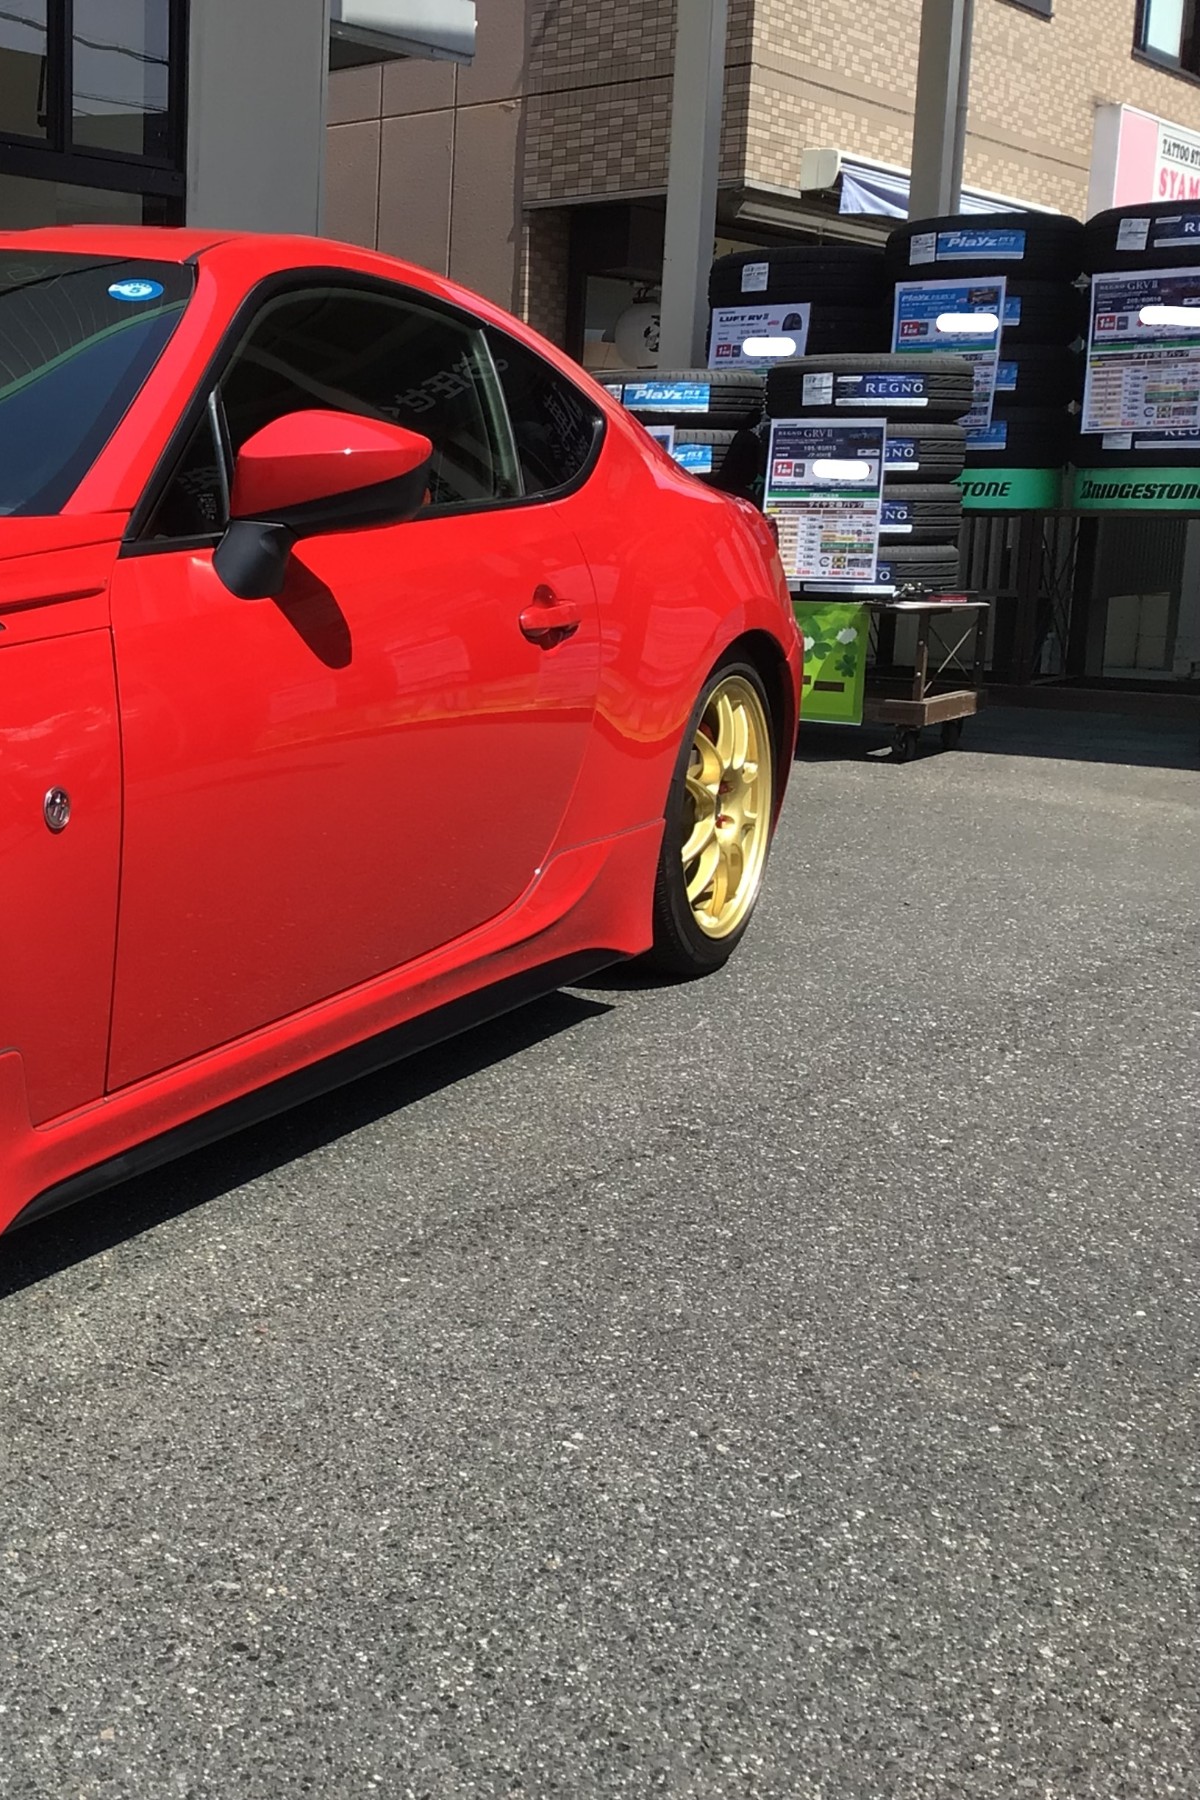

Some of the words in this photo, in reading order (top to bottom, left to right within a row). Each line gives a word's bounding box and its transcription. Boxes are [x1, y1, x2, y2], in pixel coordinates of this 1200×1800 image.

[1162, 138, 1190, 162] TATTOO
[634, 388, 683, 400] Playz
[865, 382, 924, 394] REGNO
[952, 480, 1013, 498] TONE
[1080, 479, 1200, 500] BRIDGESTON
